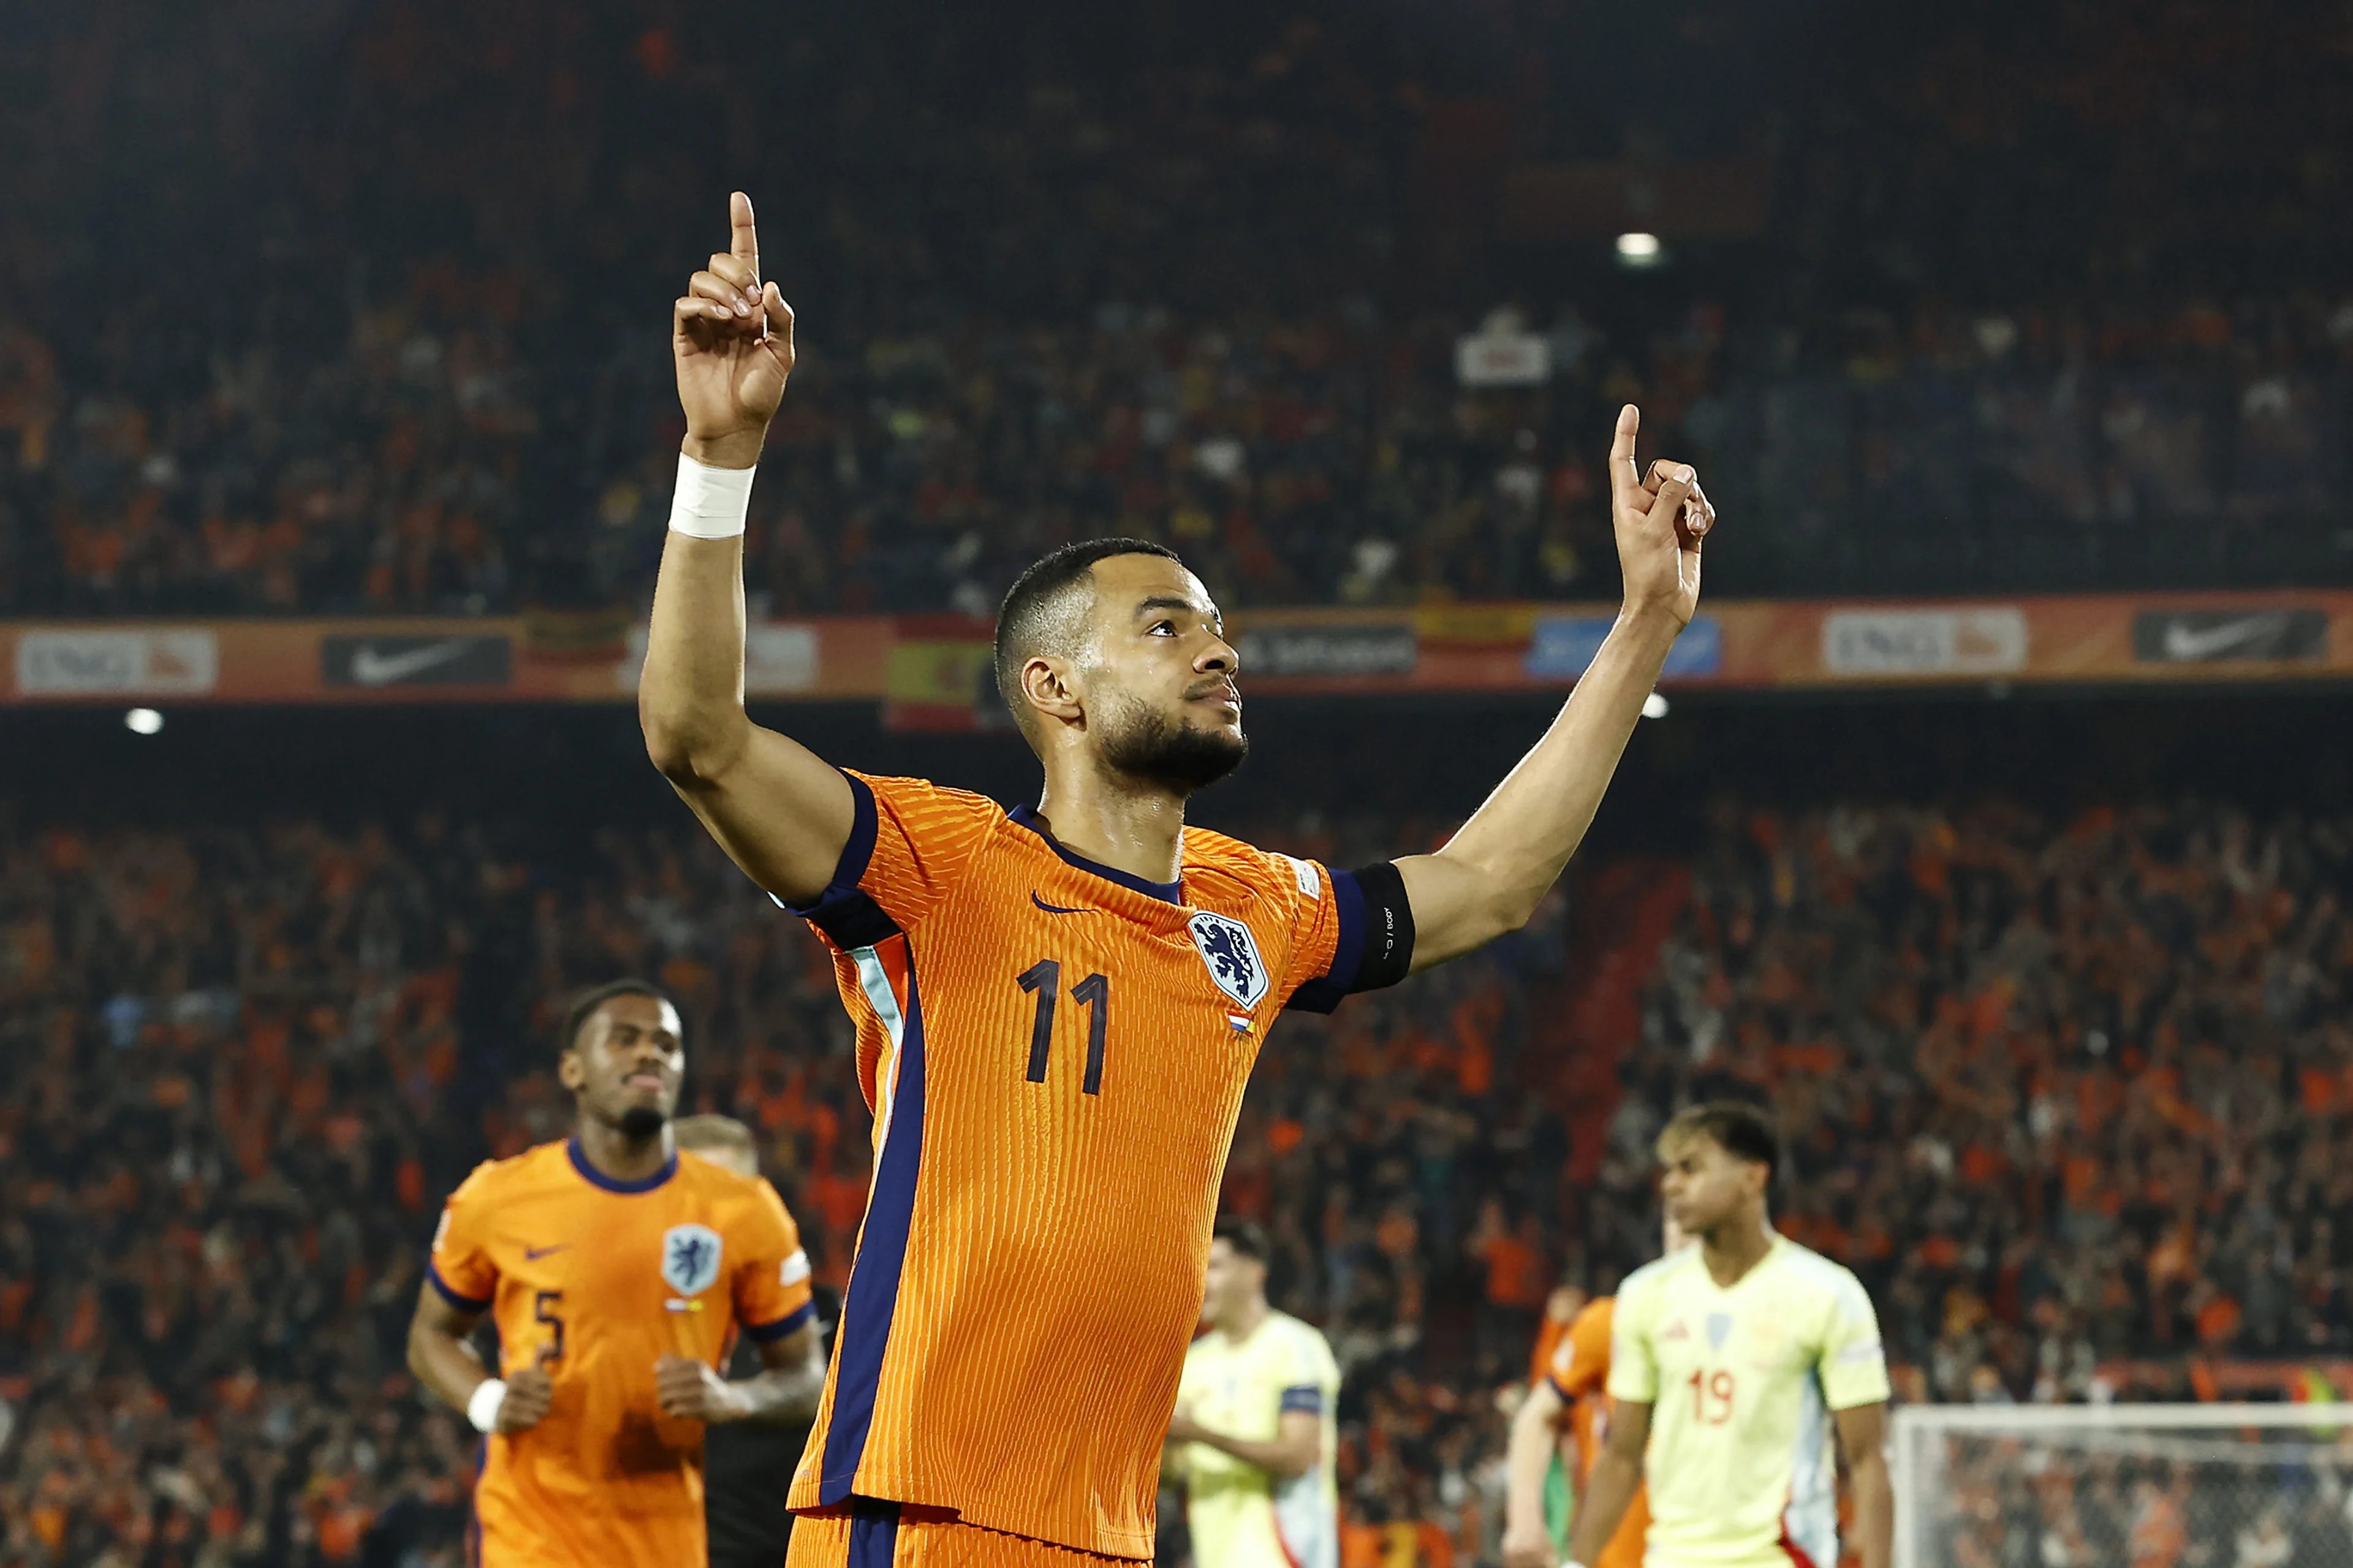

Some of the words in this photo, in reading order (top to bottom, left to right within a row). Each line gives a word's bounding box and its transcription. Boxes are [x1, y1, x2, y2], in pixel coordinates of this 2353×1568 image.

[1384, 907, 1393, 930] BODY
[1016, 959, 1108, 1096] 11
[536, 1292, 563, 1360] 5
[1689, 1369, 1733, 1424] 19
